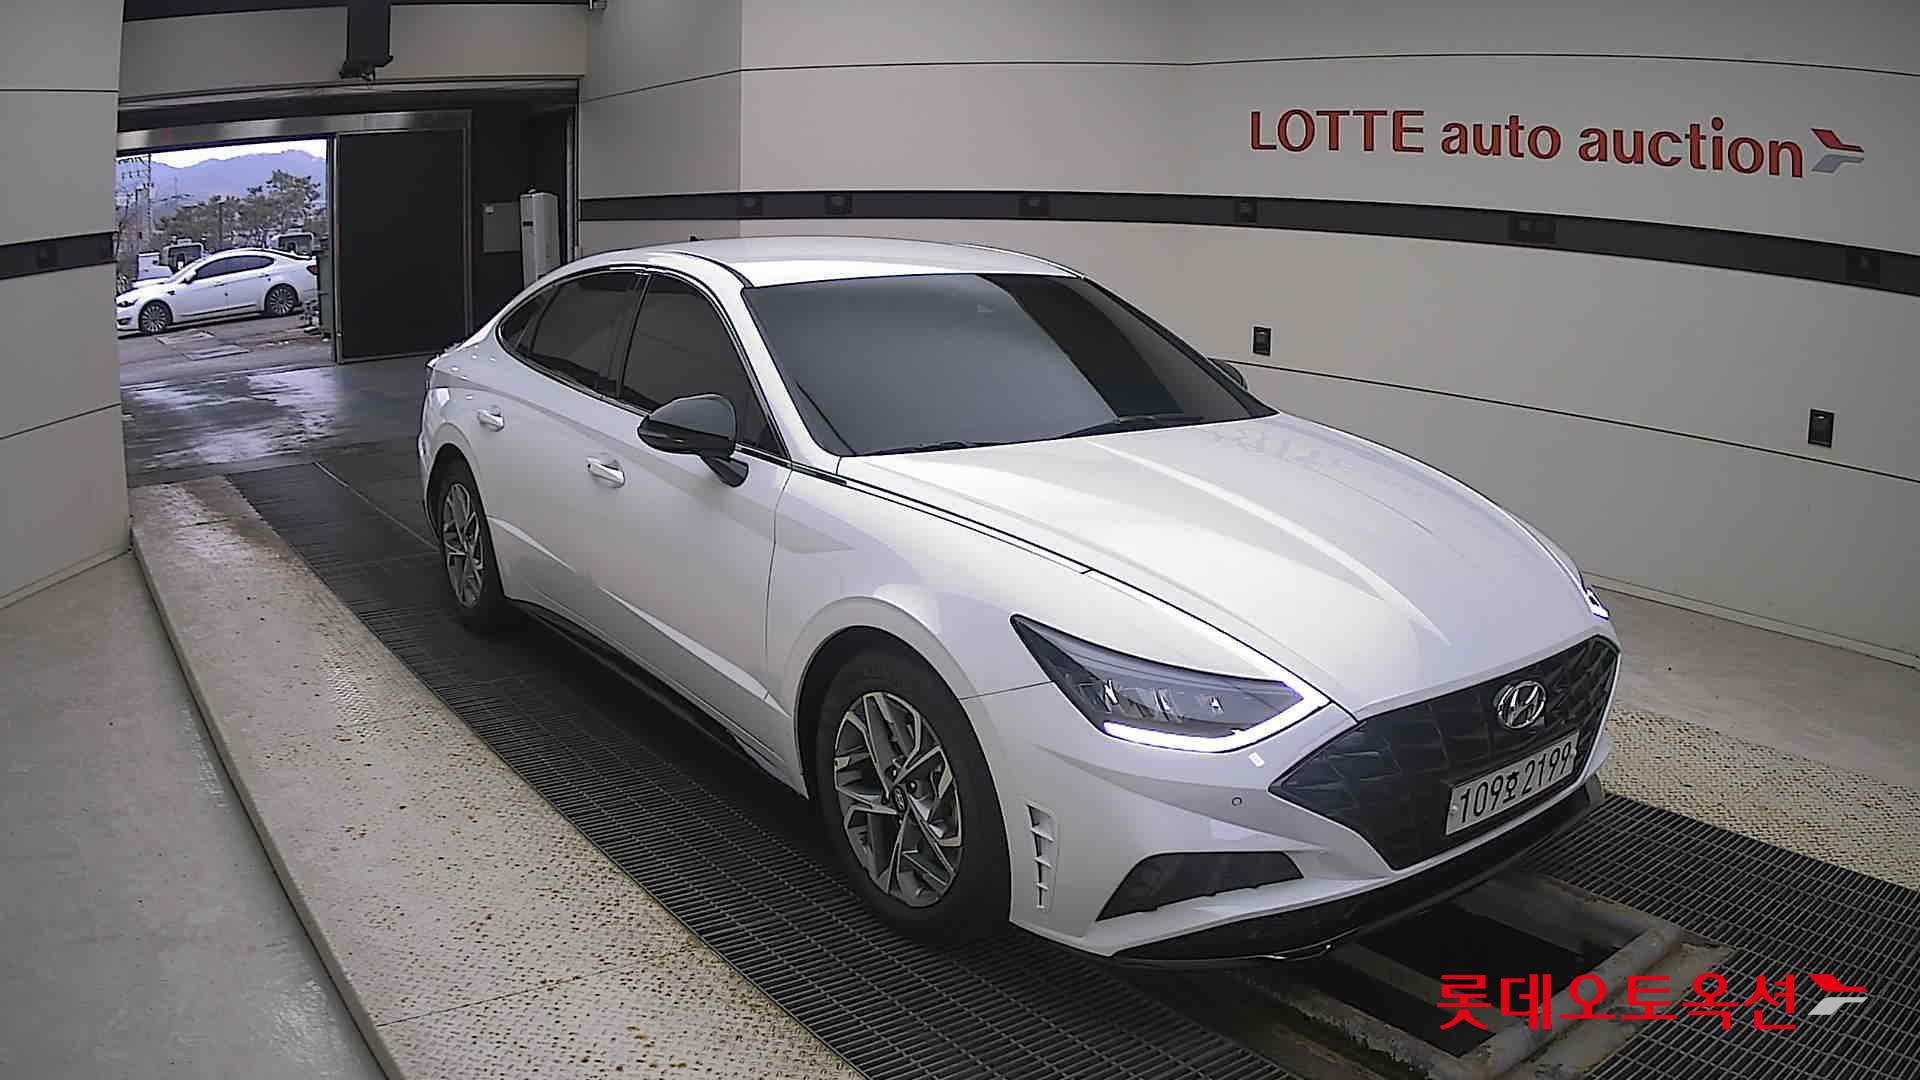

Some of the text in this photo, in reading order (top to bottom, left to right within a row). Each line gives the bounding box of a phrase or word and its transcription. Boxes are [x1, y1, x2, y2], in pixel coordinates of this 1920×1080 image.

[1250, 109, 1803, 177] LOTTE auto auction
